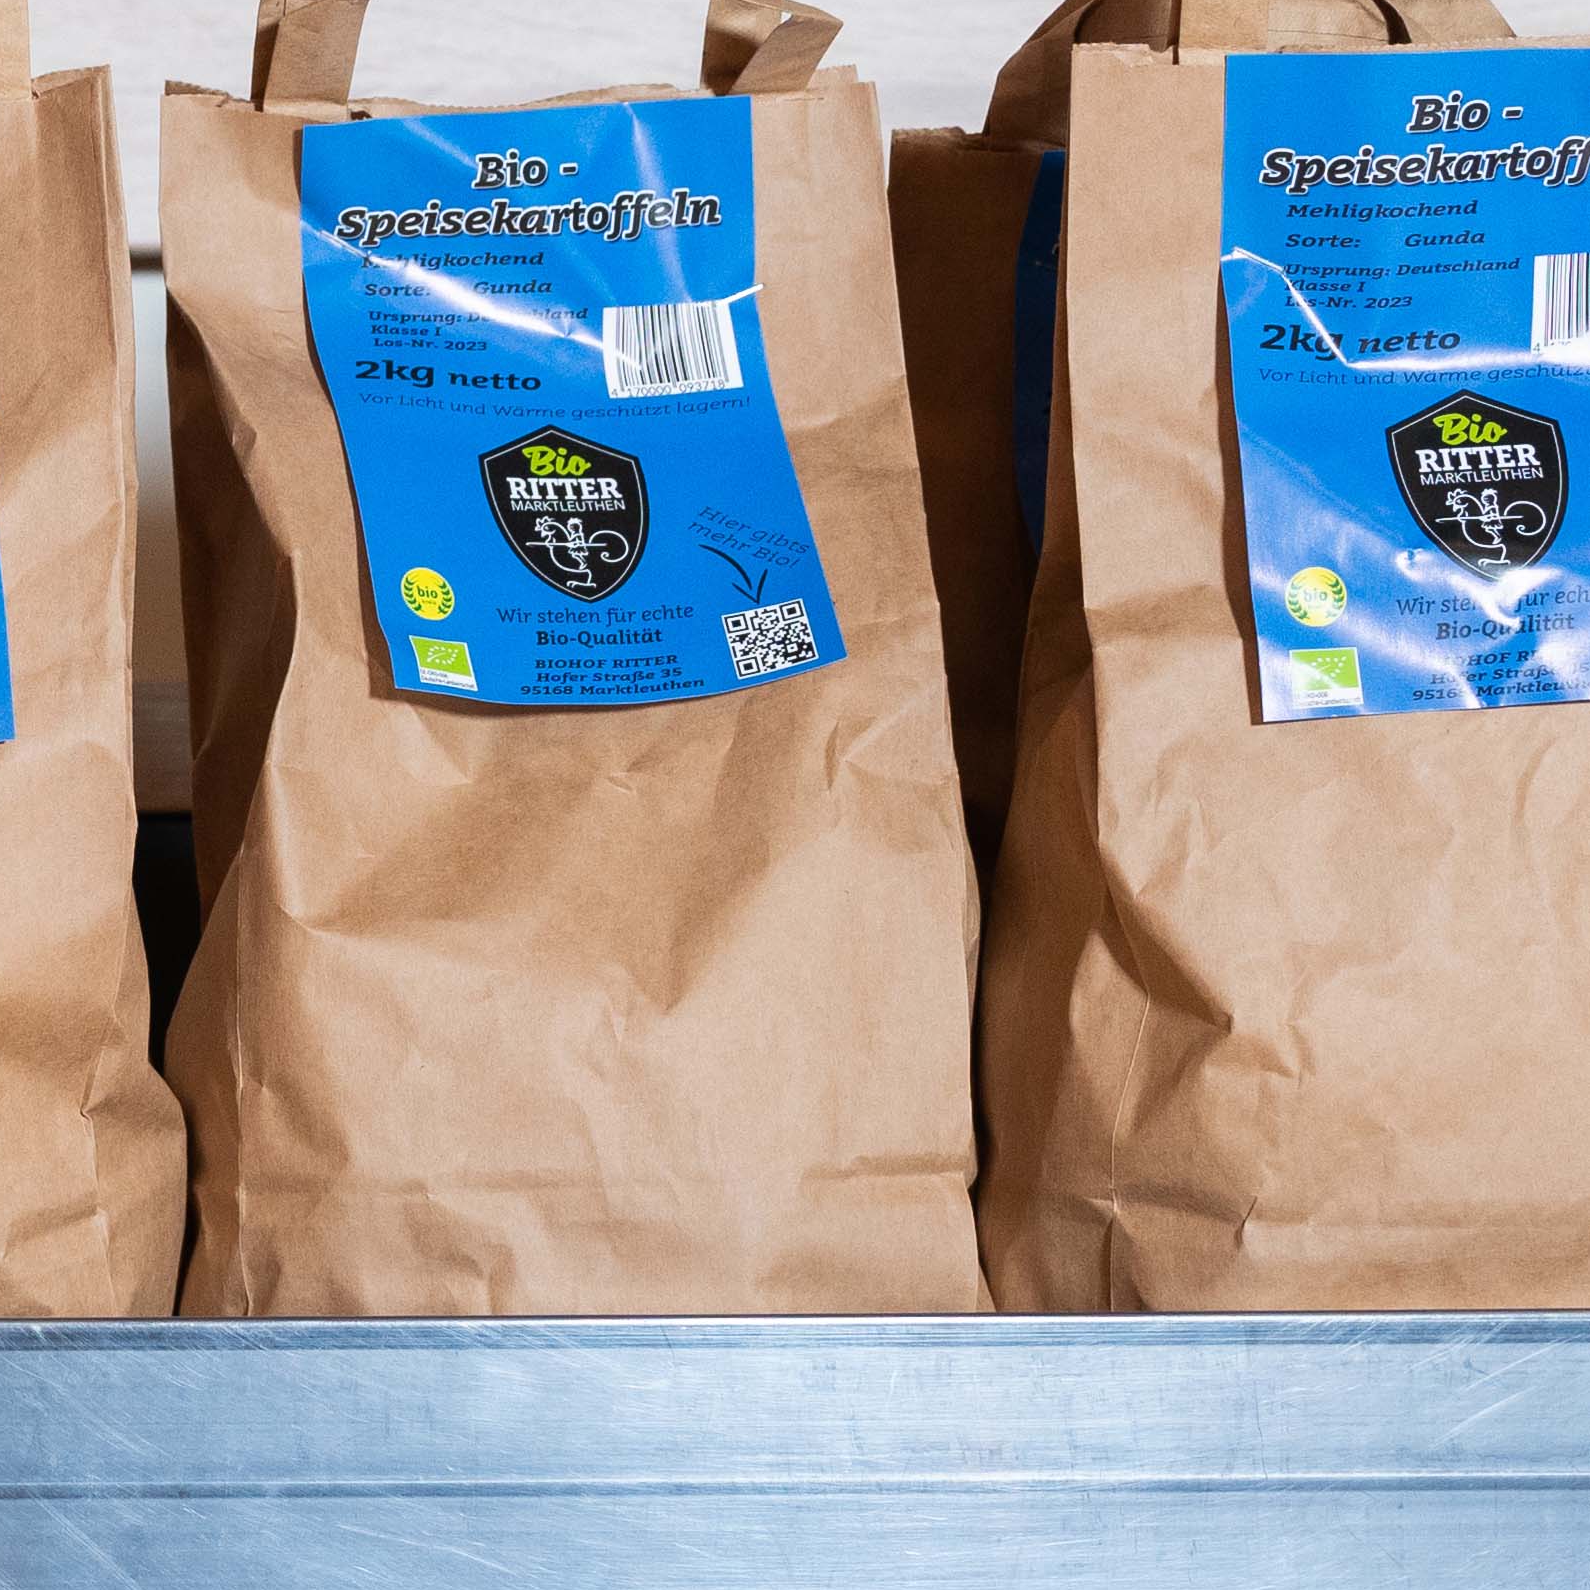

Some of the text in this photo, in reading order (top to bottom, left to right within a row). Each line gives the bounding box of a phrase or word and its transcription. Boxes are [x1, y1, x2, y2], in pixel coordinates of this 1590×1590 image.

[1406, 90, 1491, 134] Bio
[472, 148, 549, 190] Bio
[335, 188, 721, 247] Speisekartoffeln
[1286, 200, 1477, 222] Mehligkochend
[1285, 232, 1485, 248] Sorte: Gunda
[474, 280, 552, 296] Gunda
[1358, 330, 1460, 354] netto
[355, 360, 541, 391] 2kg netto
[1433, 413, 1508, 446] Bio
[522, 445, 591, 477] Bio
[1415, 443, 1540, 473] RITTER
[1420, 467, 1544, 485] MARKTLEUTHEN
[506, 477, 622, 501] RITTER
[510, 498, 625, 512] MARKTLEUTHEN
[536, 628, 663, 647] Bio-Qualität
